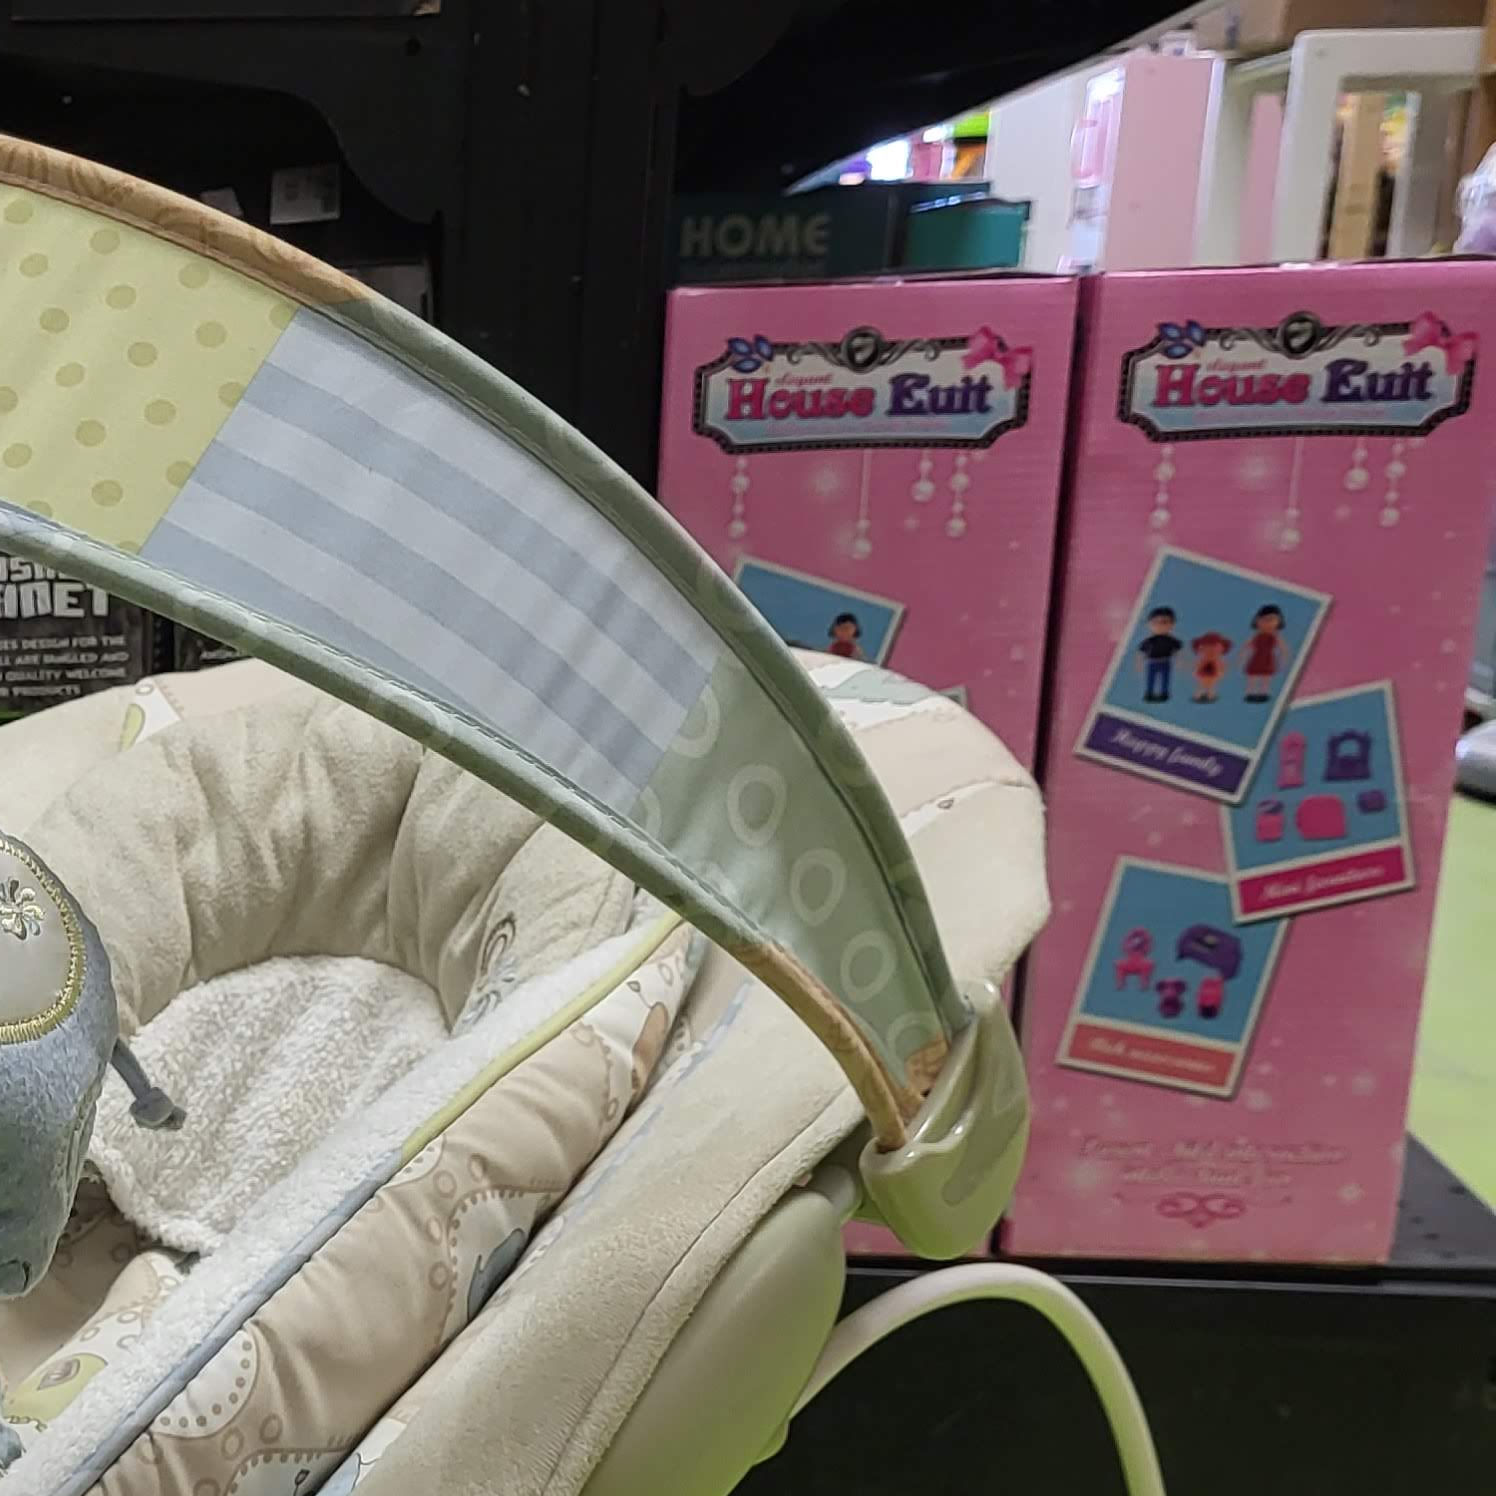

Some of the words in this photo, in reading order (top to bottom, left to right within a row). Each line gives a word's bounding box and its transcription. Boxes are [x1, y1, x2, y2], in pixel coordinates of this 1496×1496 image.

[680, 213, 831, 257] HOME
[724, 377, 877, 421] House
[1152, 363, 1311, 408] House
[72, 635, 98, 648] FOR
[102, 634, 126, 647] THE
[5, 669, 61, 682] QUALITY
